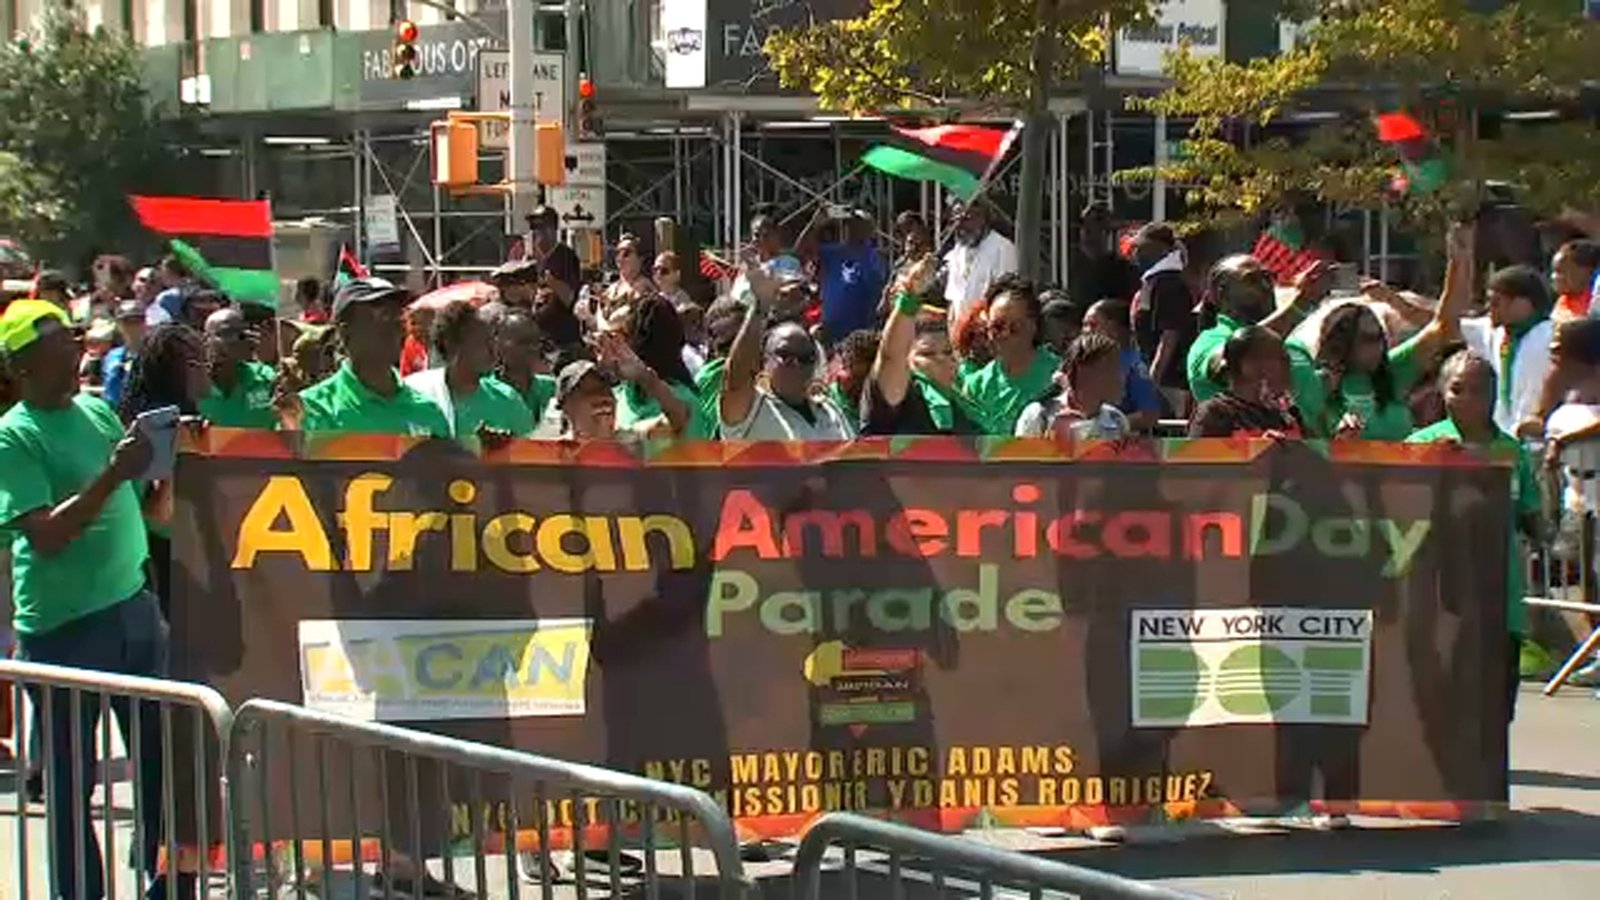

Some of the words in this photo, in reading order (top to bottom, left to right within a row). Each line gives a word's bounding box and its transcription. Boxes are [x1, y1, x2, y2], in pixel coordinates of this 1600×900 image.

[363, 41, 447, 80] FABOUS
[485, 62, 509, 78] LEF
[533, 64, 558, 80] ANE
[231, 472, 696, 573] African
[714, 484, 1242, 560] American
[1250, 493, 1432, 579] Day
[706, 565, 1064, 639] Parade
[1139, 616, 1204, 636] NEW
[1221, 614, 1285, 635] YORK
[1299, 615, 1366, 635] CITY
[645, 758, 712, 787] NYC
[730, 750, 844, 785] MAYOR
[852, 746, 929, 777] ERIC
[947, 745, 1076, 778] ADAMS
[887, 777, 1019, 808] YDANIS
[1037, 770, 1213, 806] RODRIGUEZ
